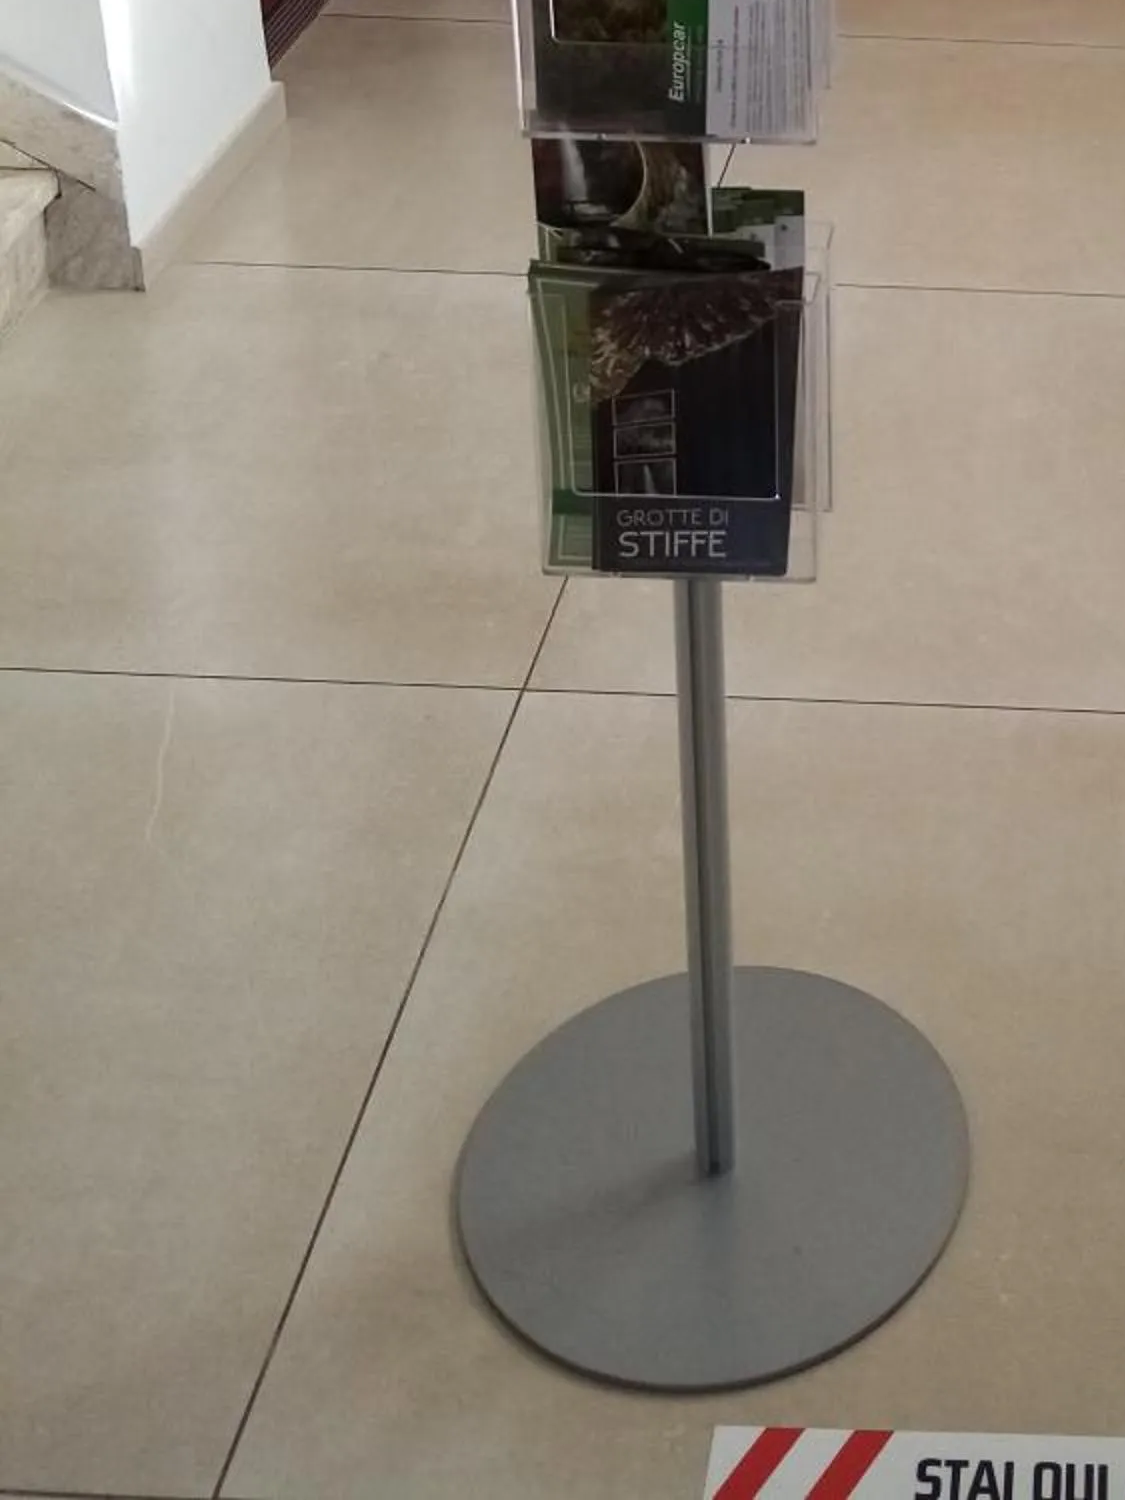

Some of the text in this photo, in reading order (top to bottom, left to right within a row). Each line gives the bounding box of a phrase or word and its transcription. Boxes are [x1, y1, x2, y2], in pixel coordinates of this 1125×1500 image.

[668, 20, 690, 103] Europcar
[617, 509, 729, 528] GROTTE DI
[618, 531, 728, 558] STIFFE
[914, 1458, 1015, 1500] STAI
